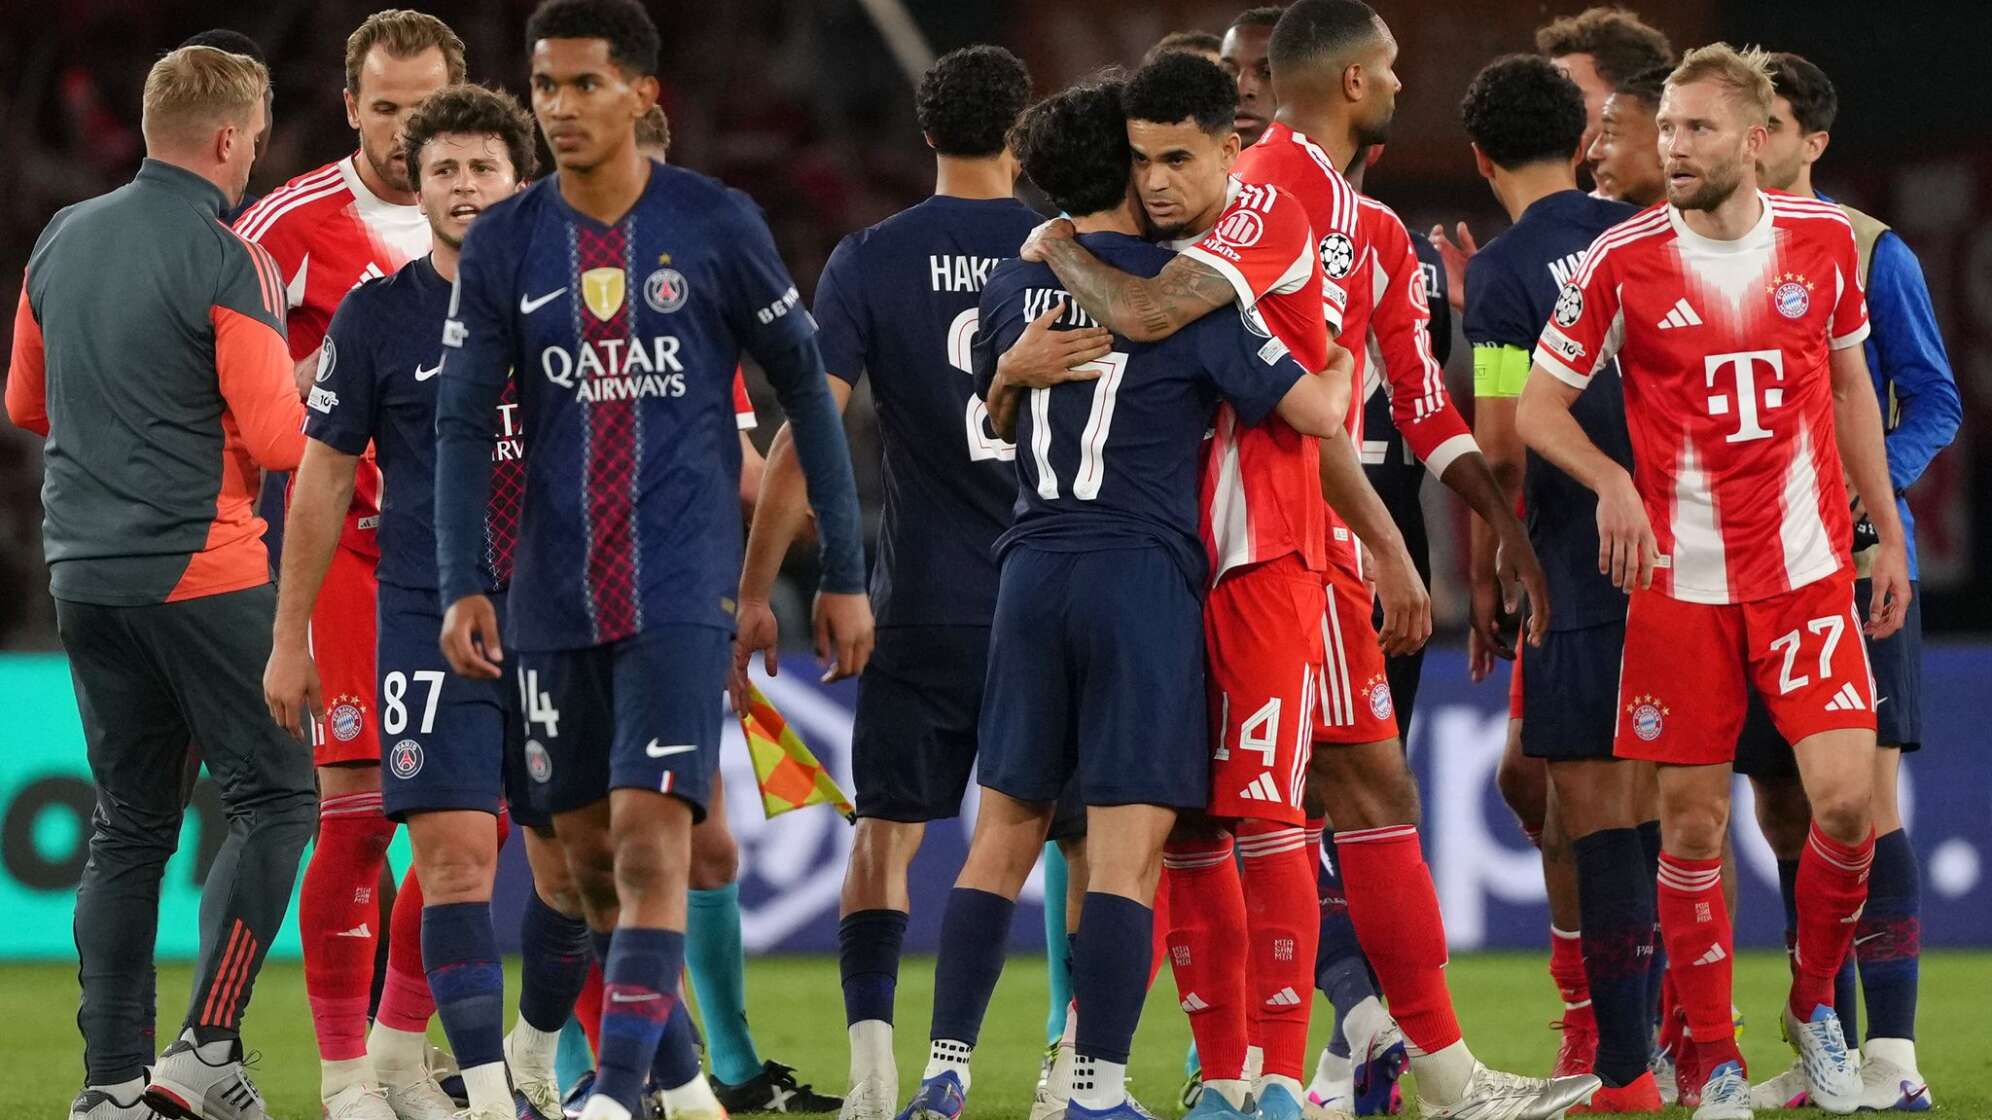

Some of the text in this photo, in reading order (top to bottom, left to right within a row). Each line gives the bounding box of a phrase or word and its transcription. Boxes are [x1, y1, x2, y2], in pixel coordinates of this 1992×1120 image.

[930, 255, 999, 292] HAK
[542, 336, 684, 389] QATAR
[576, 373, 687, 403] AIRWAYS
[1029, 351, 1129, 500] 17
[1770, 614, 1845, 696] 27
[384, 670, 446, 736] 87
[1213, 691, 1282, 767] 14
